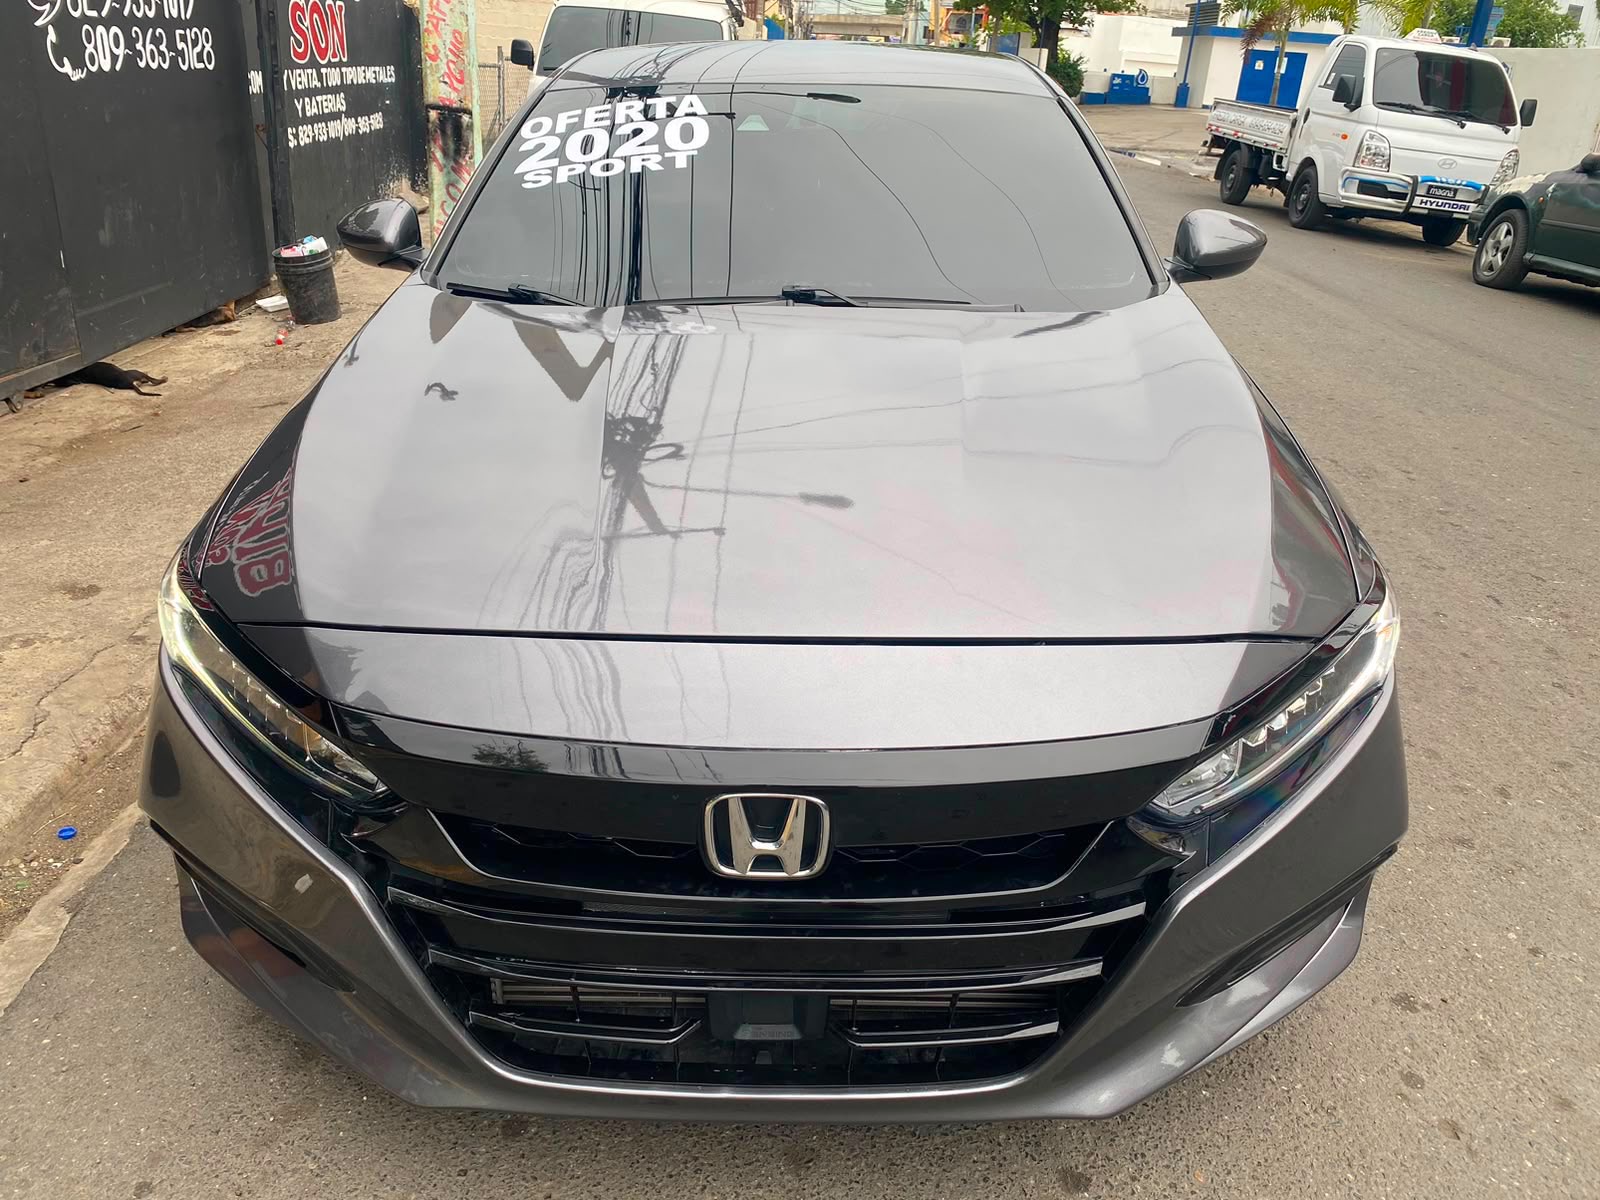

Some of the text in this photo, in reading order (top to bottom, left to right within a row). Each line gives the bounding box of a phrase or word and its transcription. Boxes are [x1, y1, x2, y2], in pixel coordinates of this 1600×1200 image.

[288, 0, 348, 64] SON
[320, 67, 341, 87] TODO
[365, 64, 396, 84] METALES
[294, 92, 347, 118] Y BATERIAS
[520, 94, 709, 140] OFERTA
[513, 116, 710, 175] 2020
[521, 150, 699, 189] SPORT
[1419, 199, 1472, 211] HYUNDAI
